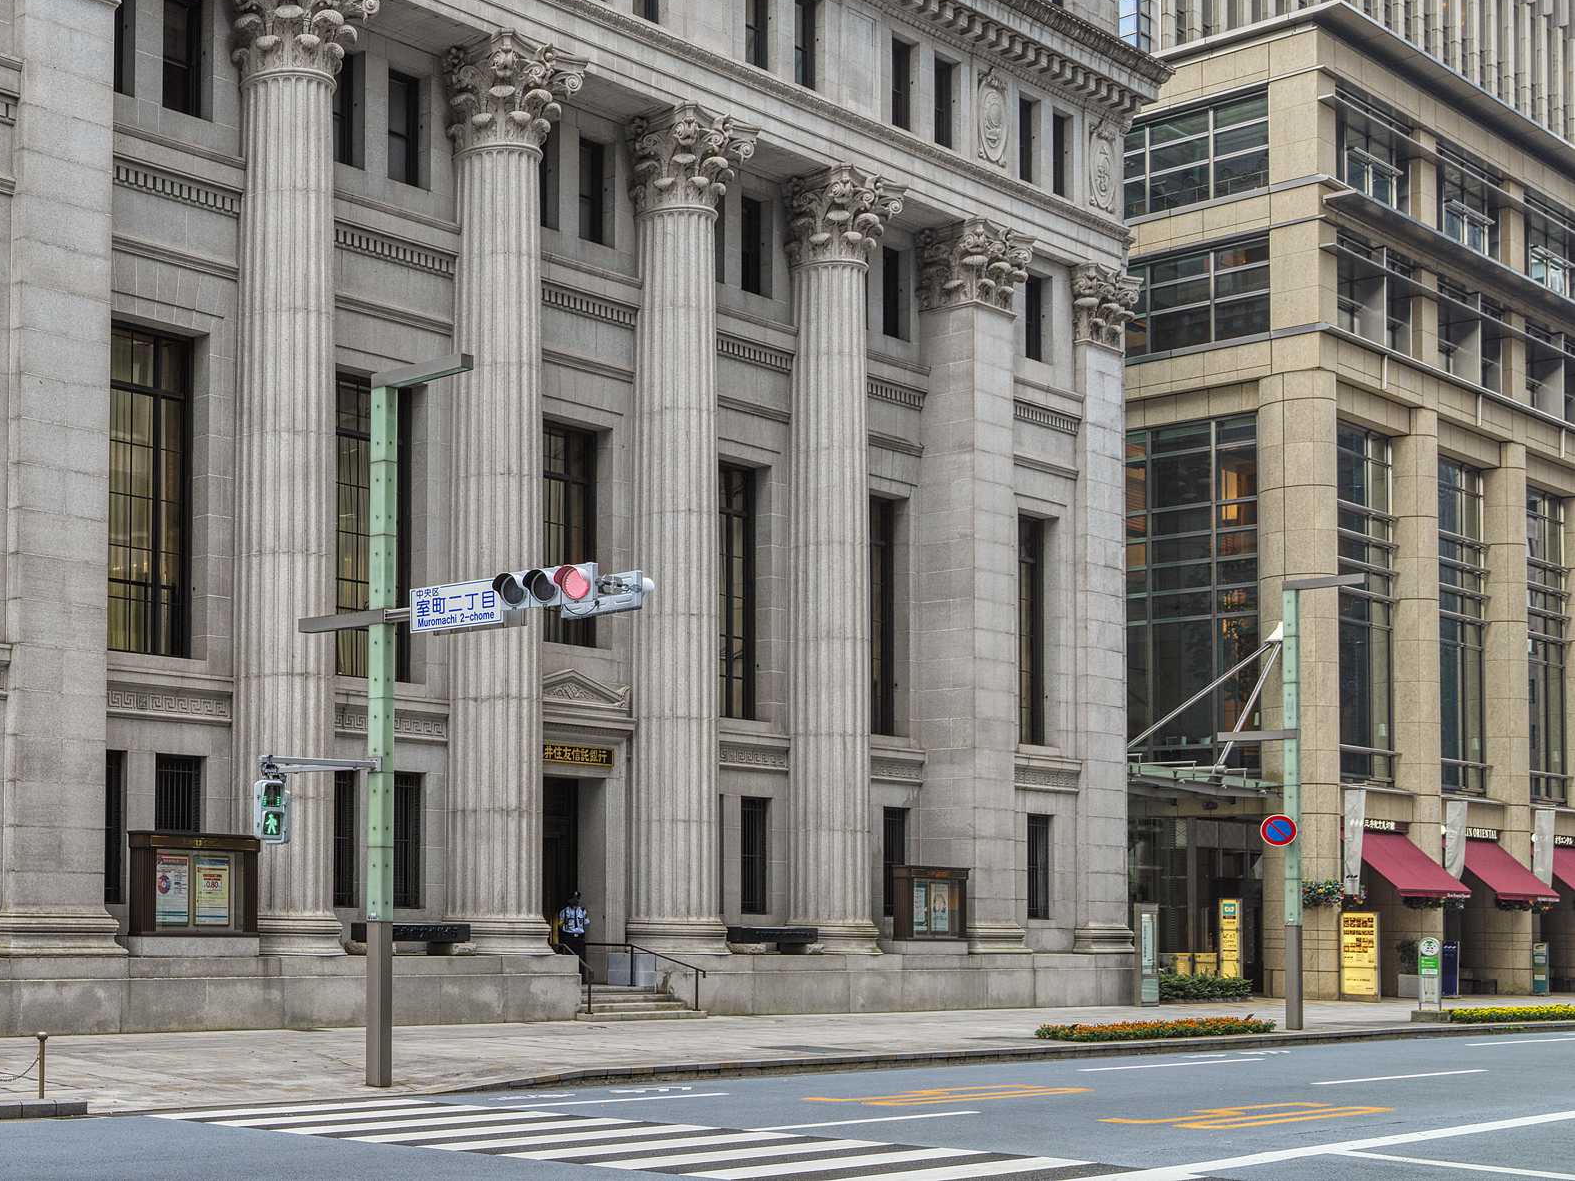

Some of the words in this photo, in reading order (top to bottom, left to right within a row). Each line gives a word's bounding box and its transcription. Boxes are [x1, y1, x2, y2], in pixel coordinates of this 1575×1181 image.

[416, 587, 439, 599] 中央区
[417, 590, 494, 617] 室町二丁目
[418, 614, 457, 627] Muromachi
[460, 611, 494, 623] 2-chome
